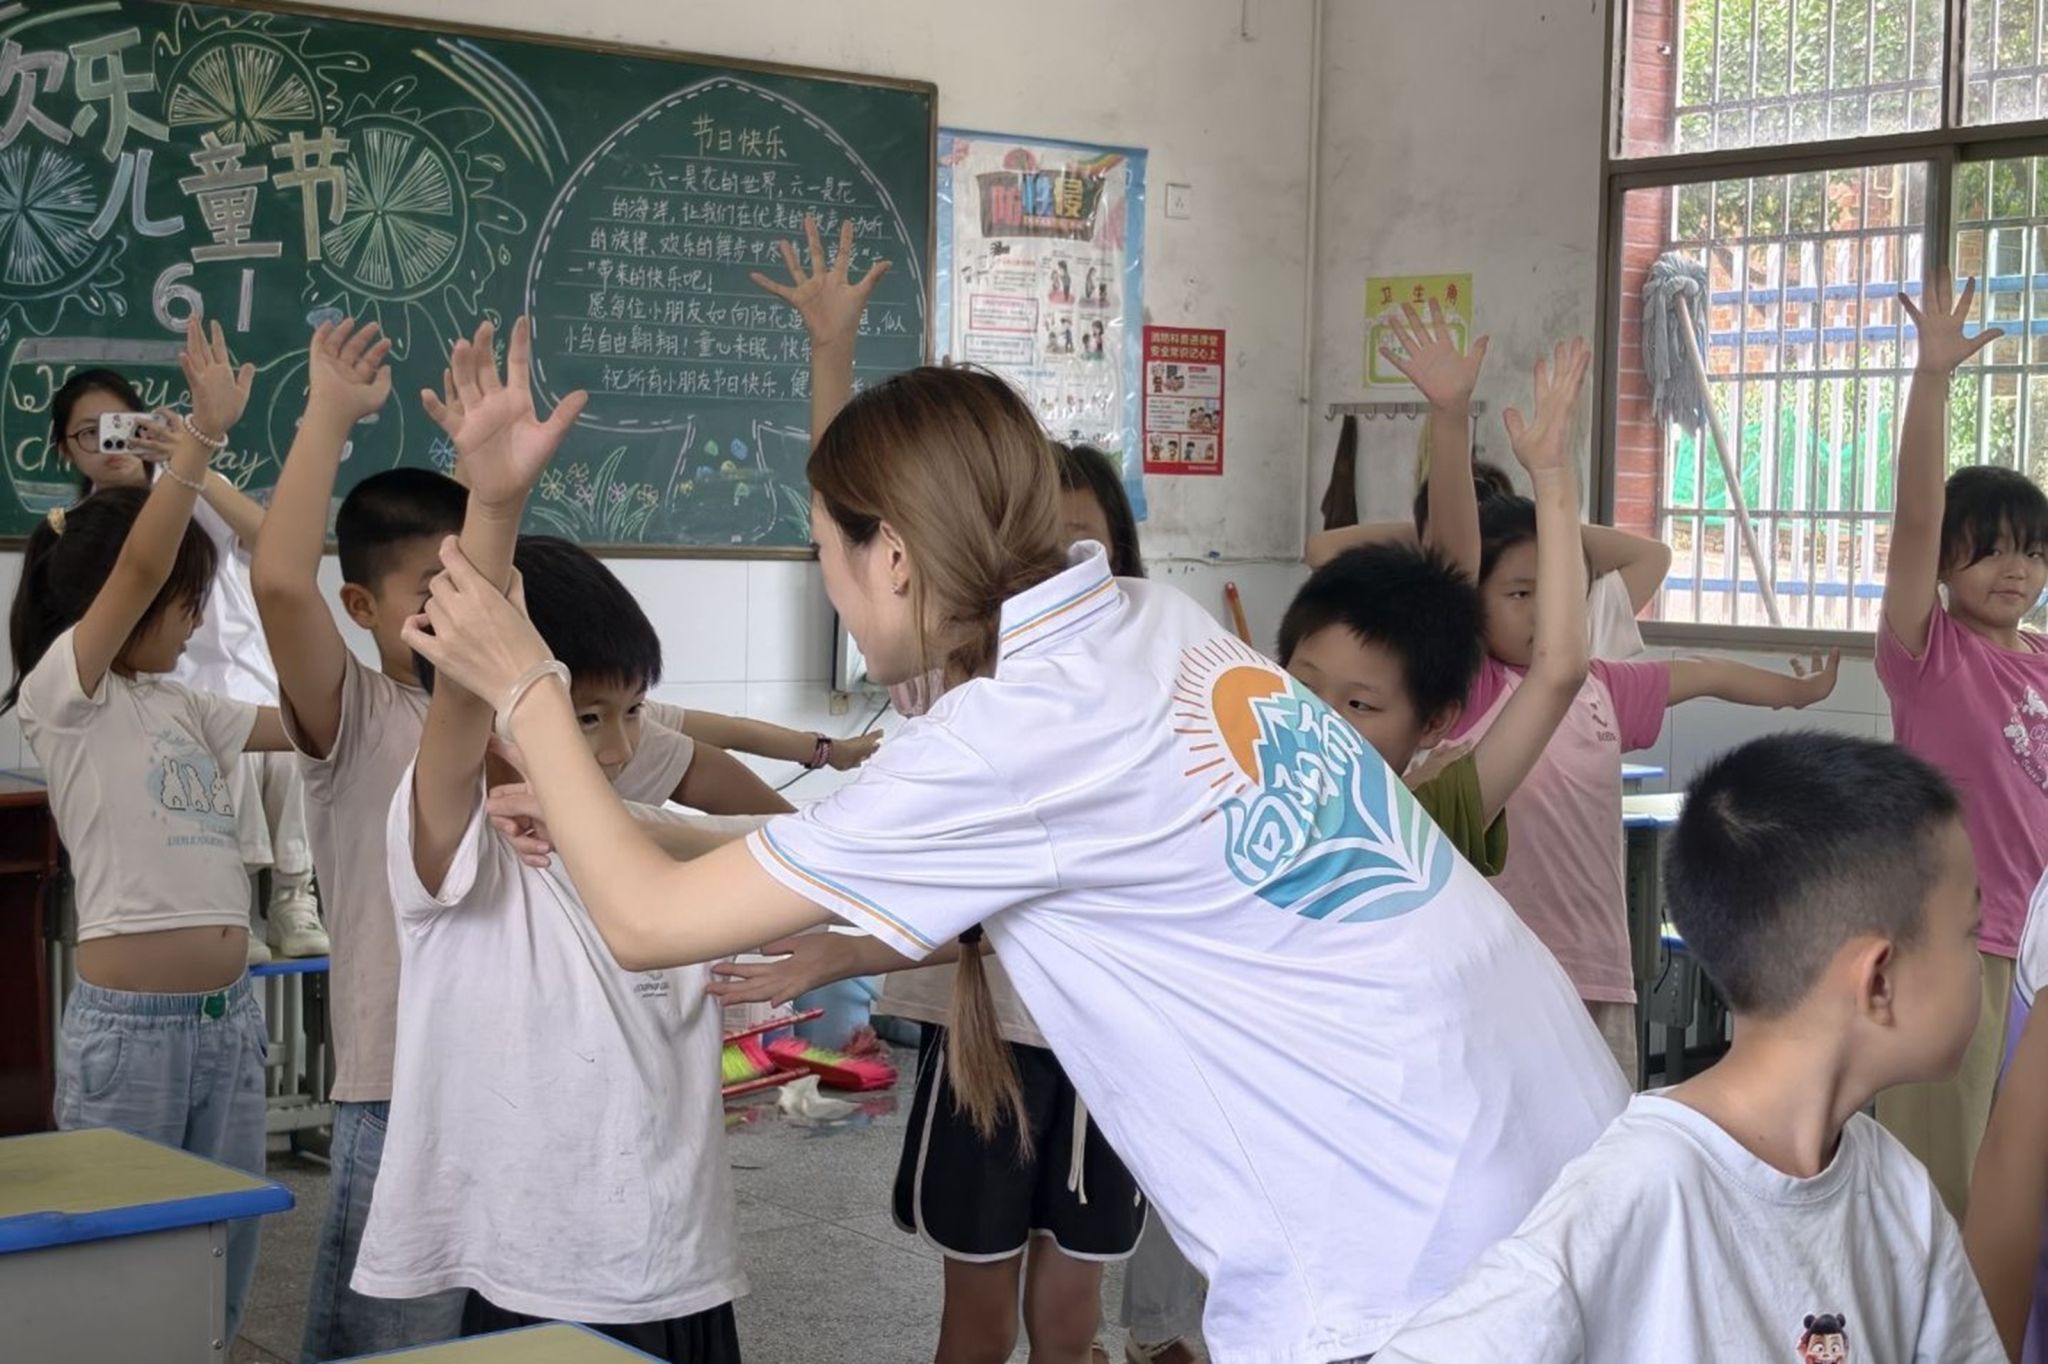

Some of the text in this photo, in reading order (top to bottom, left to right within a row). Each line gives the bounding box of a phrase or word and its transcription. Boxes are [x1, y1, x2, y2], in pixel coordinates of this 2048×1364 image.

[692, 113, 787, 160] 节日快乐
[88, 127, 350, 262] 儿童节
[1380, 283, 1458, 305] 卫生角
[207, 449, 272, 490] ay
[1229, 702, 1364, 882] 向阳而
